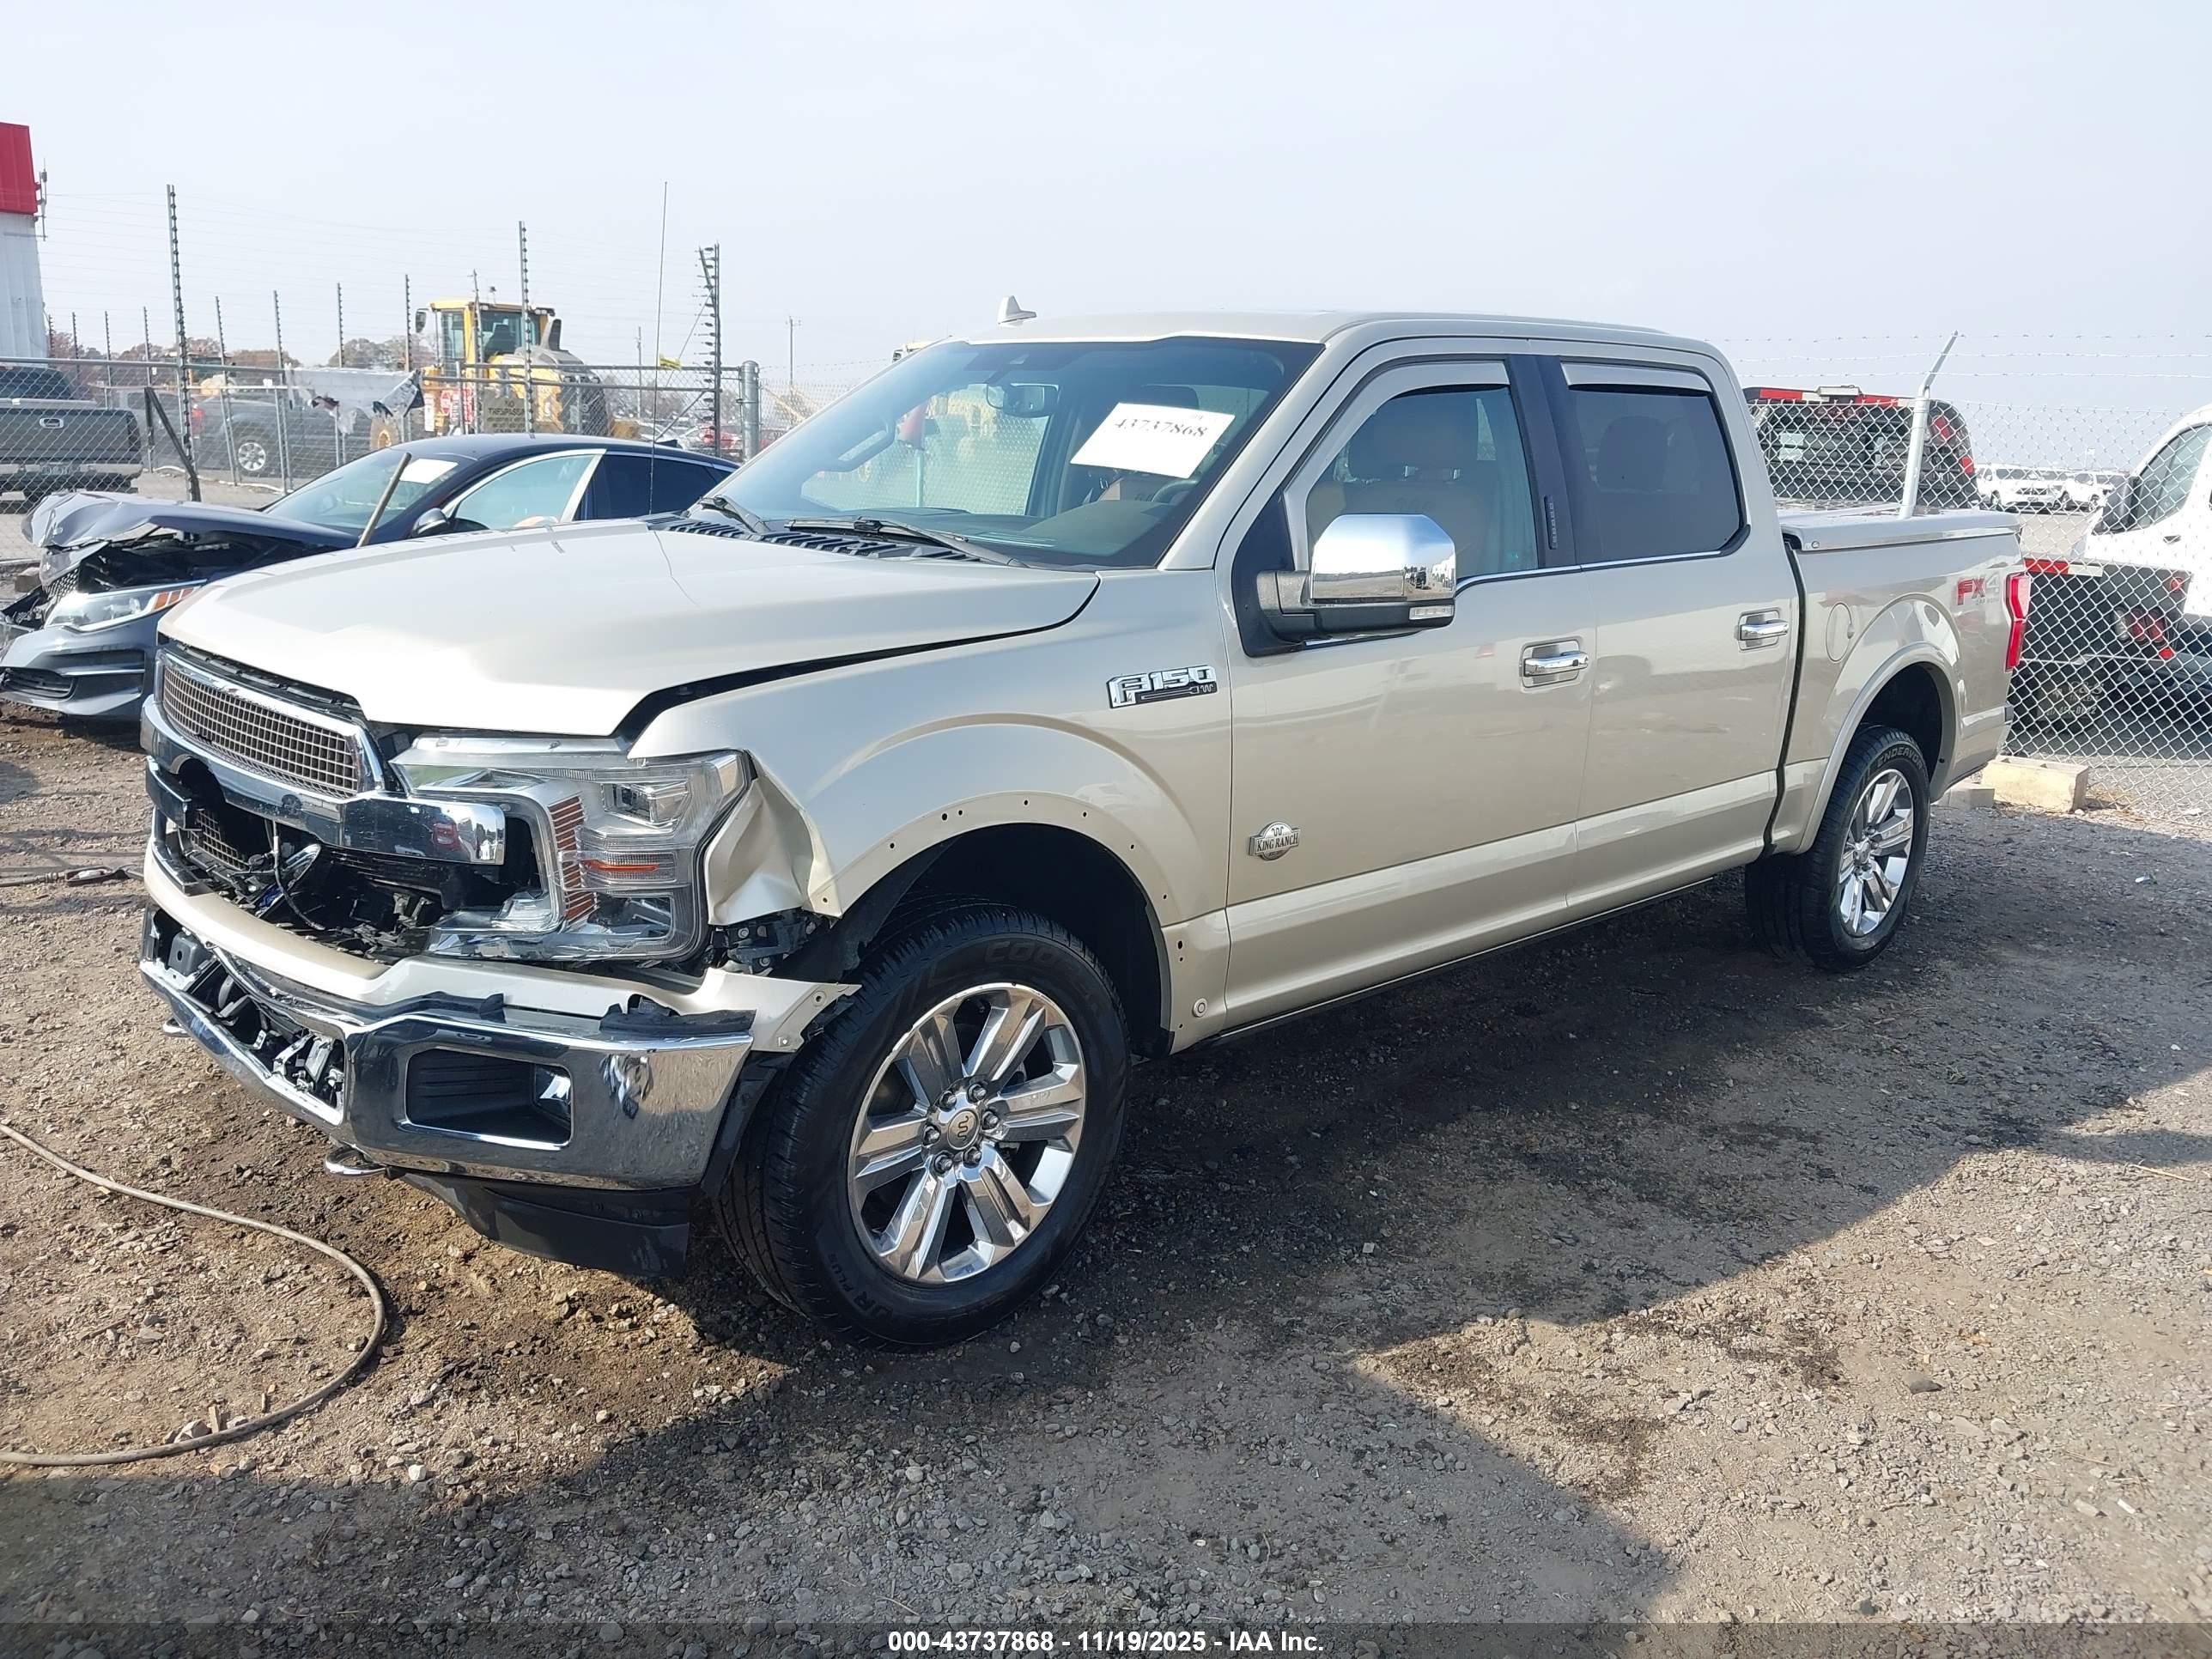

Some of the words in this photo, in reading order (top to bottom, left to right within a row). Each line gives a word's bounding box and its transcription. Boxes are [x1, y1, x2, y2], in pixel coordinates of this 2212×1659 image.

[1115, 417, 1208, 438] 43737868
[1957, 573, 2000, 605] FX4
[1877, 745, 1923, 770] ENDEAVOR
[1256, 839, 1274, 852] KING
[1275, 832, 1299, 848] RANCH
